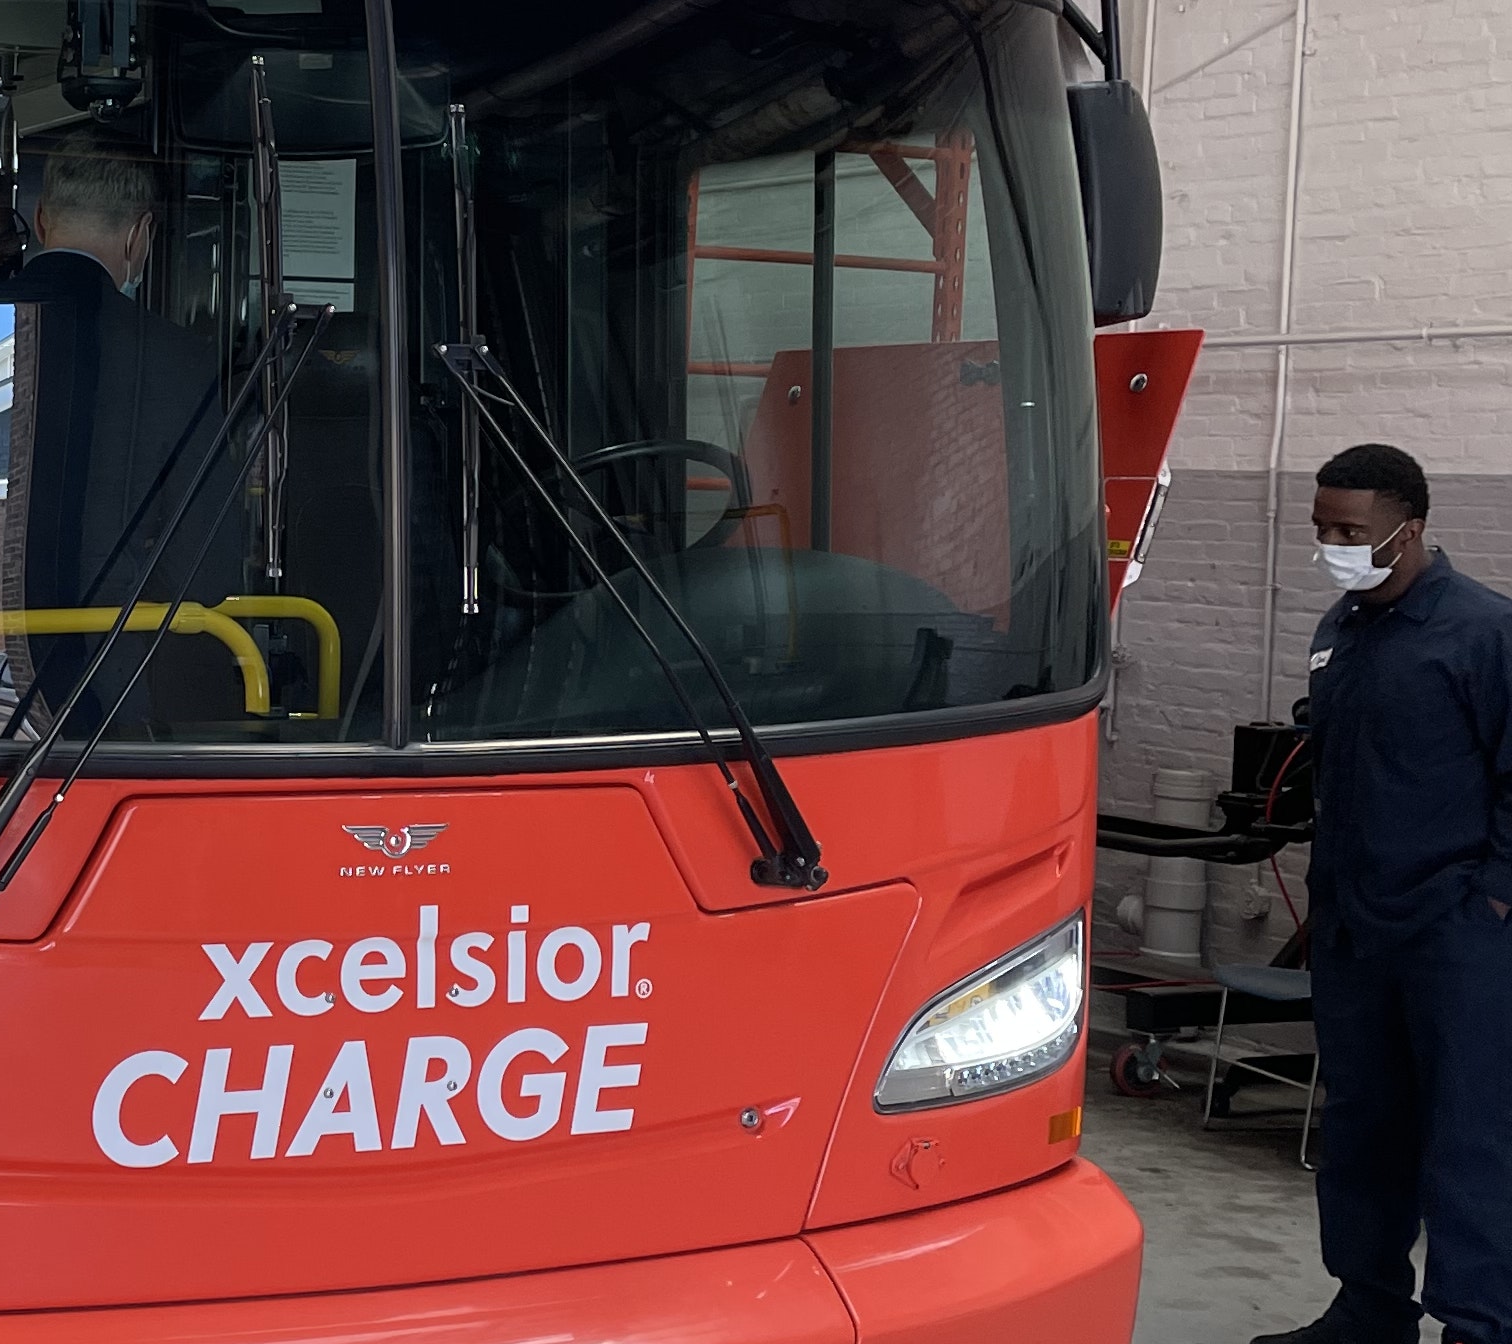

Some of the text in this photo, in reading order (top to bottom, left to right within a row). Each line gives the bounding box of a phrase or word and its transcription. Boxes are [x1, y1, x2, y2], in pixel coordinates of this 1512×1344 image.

[339, 863, 451, 877] NEW FLYER
[92, 1022, 649, 1168] CHARGE
